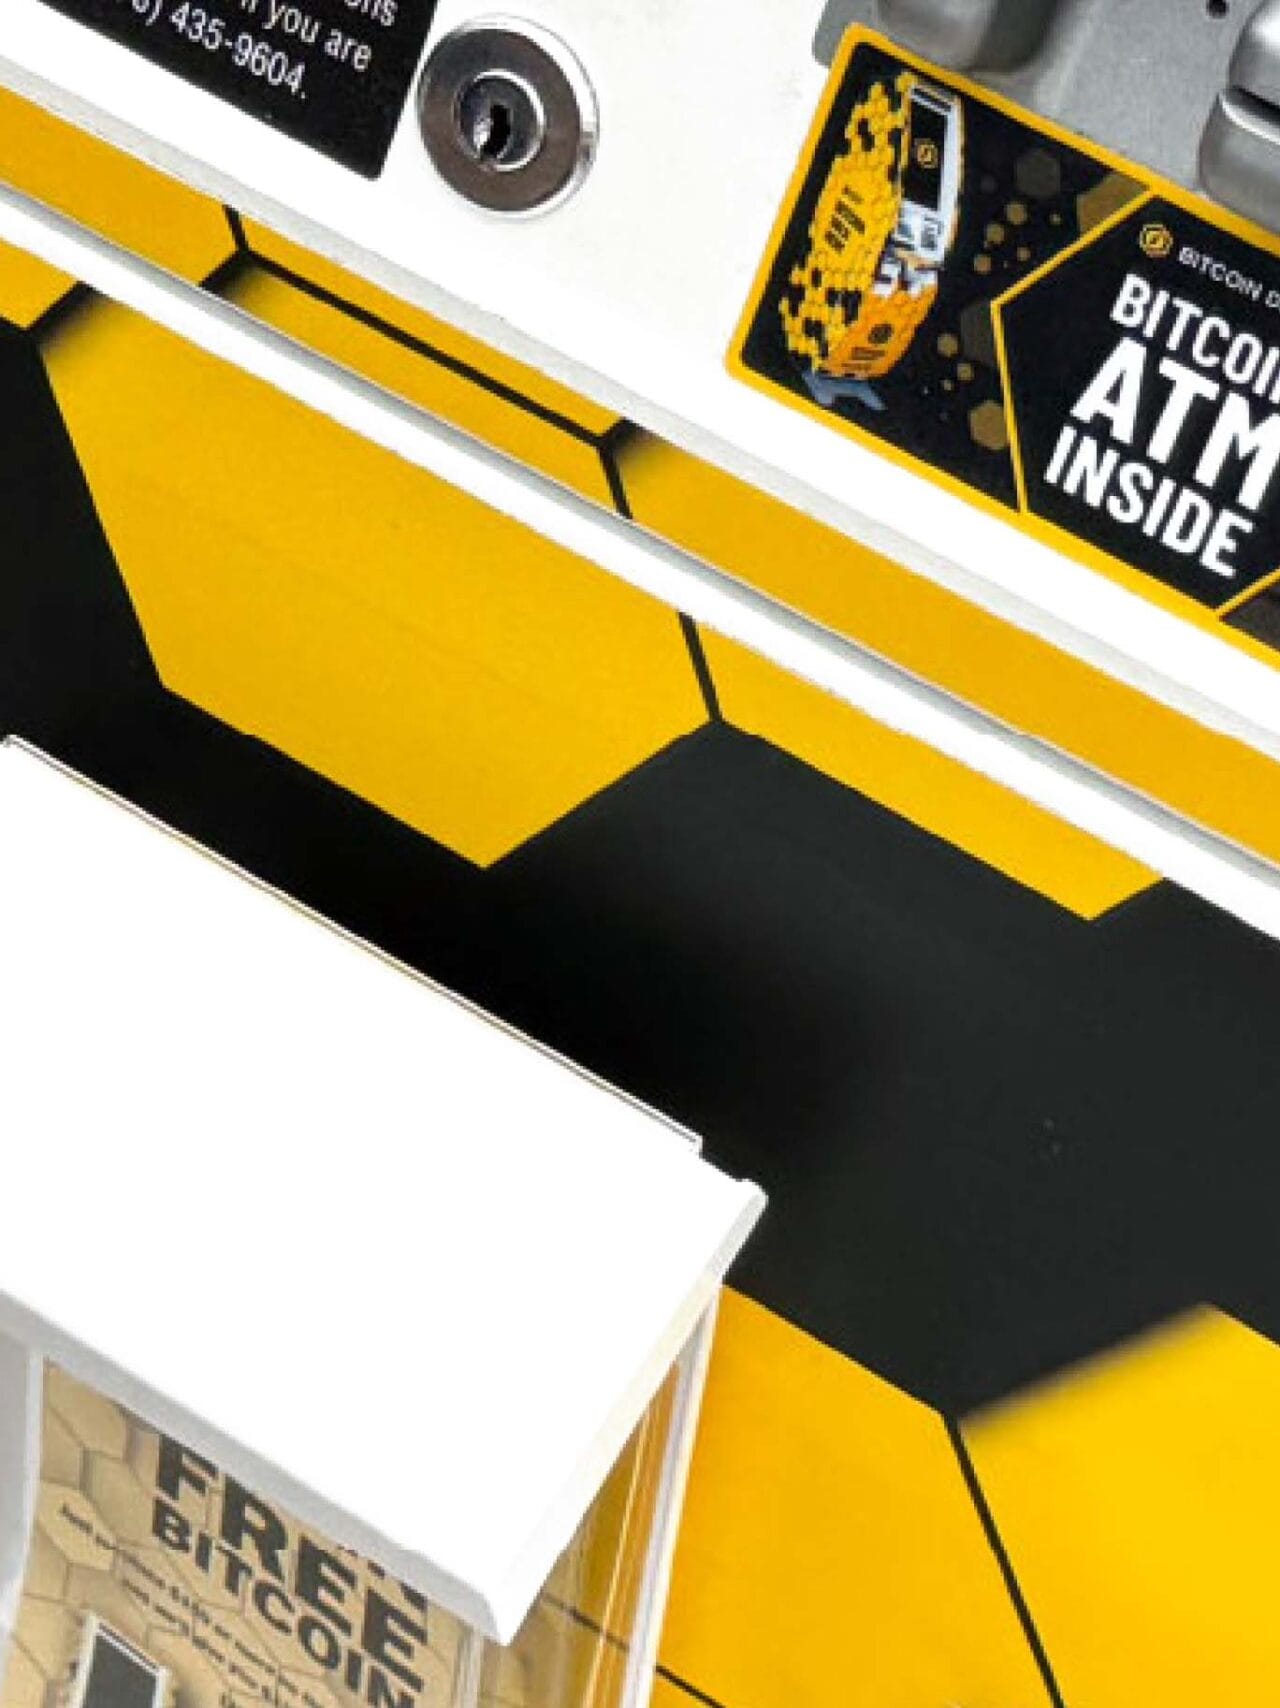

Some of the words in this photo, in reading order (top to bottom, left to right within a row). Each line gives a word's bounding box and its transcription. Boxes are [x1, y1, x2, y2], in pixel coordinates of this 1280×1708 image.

[170, 2, 307, 99] 435-9604.
[263, 0, 320, 43] you
[324, 29, 371, 72] are
[1179, 247, 1262, 301] BITCOIN
[1070, 336, 1280, 512] ATM
[1044, 424, 1255, 577] INSIDE
[157, 1433, 428, 1694] FREE
